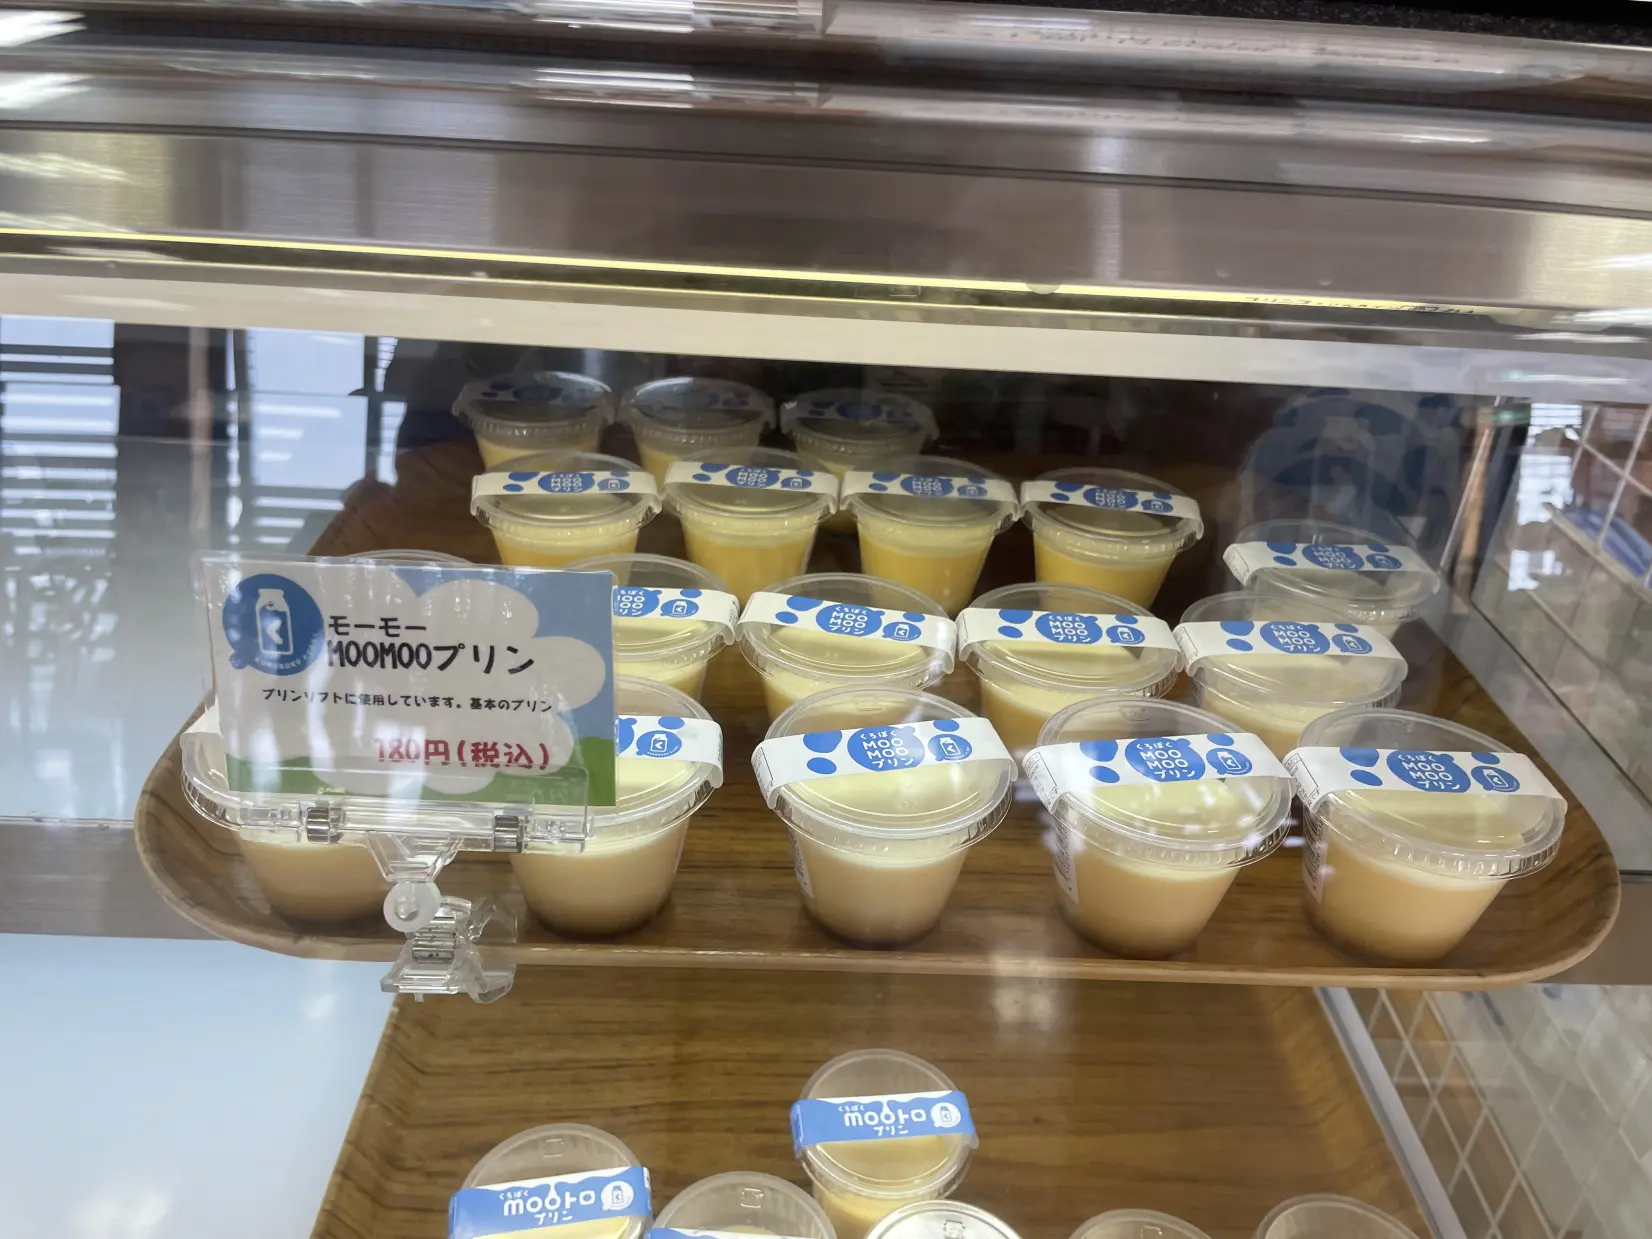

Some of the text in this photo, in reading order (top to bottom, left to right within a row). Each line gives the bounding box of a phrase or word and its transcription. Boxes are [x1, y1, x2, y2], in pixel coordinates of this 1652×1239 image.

[832, 611, 868, 622] MOO
[328, 615, 427, 637] モーモー
[829, 618, 866, 629] MOO
[1049, 621, 1086, 629] MOO
[1051, 627, 1088, 636] MOO
[1272, 630, 1310, 638] MOO
[1277, 637, 1316, 645] MOO
[327, 640, 534, 674] MOOMOOプリン
[862, 738, 903, 750] MOO
[866, 747, 908, 760] MOO
[1139, 749, 1182, 761] MOO
[872, 758, 913, 769] プリン
[1146, 759, 1189, 770] MOO
[1401, 761, 1446, 772] MOO
[1154, 769, 1196, 779] プリン
[1409, 770, 1453, 781] MOO
[1417, 780, 1461, 790] プリン
[873, 1125, 909, 1137] プリン
[534, 1210, 573, 1225] プリン
